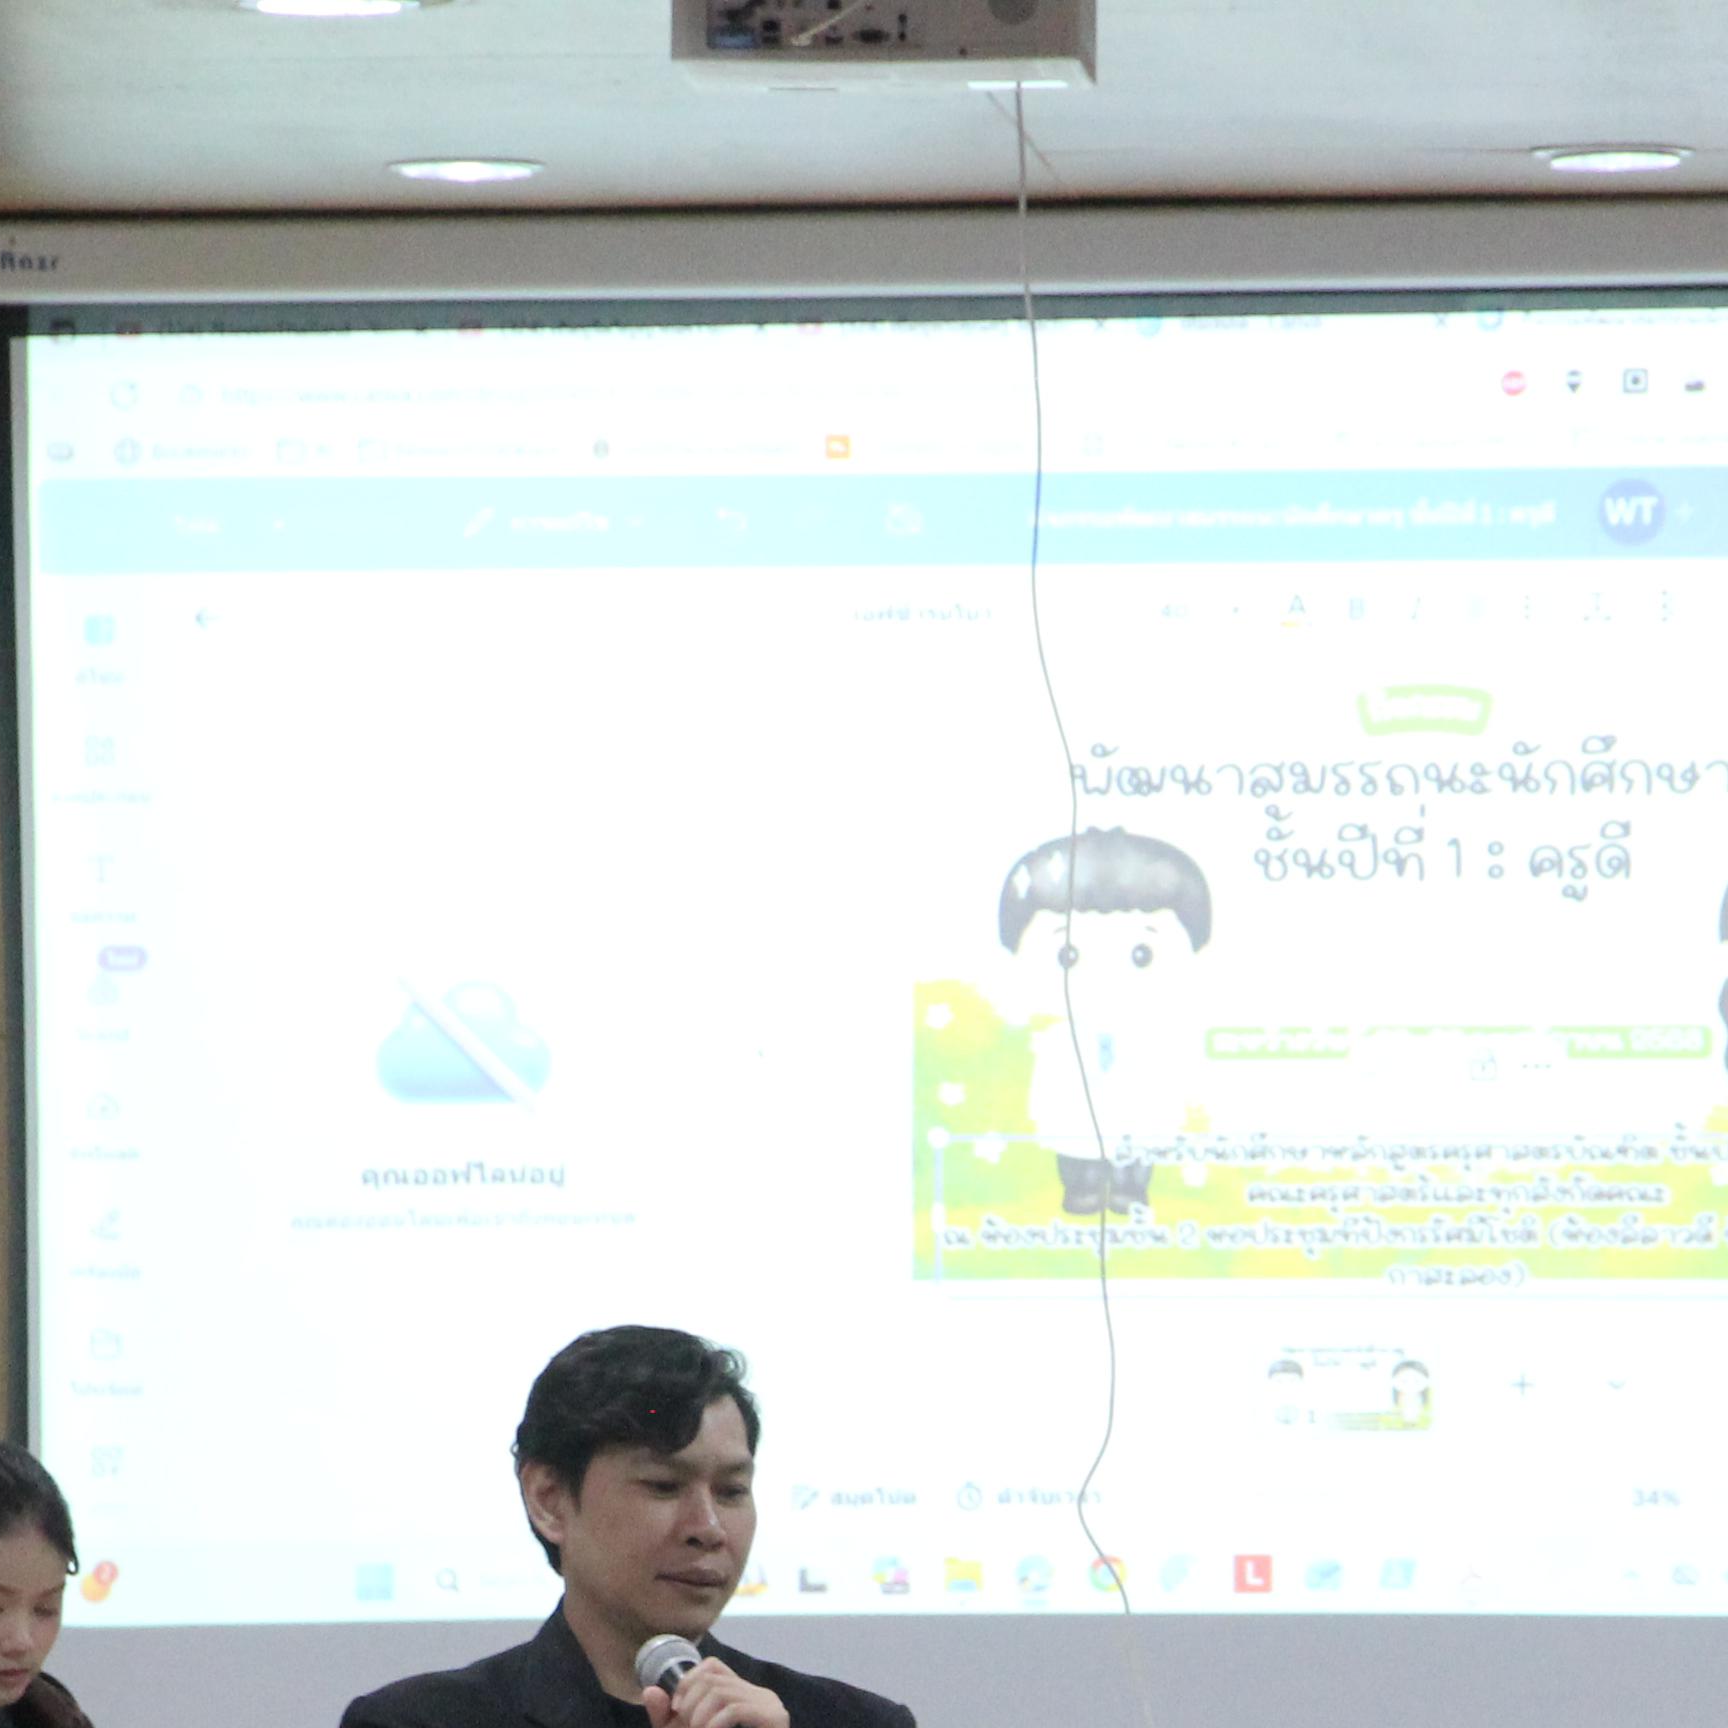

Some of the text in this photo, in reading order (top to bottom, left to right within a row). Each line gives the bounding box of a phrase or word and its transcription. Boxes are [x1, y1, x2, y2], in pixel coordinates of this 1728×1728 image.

[1605, 496, 1659, 526] WT
[1254, 804, 1425, 881] ชั้นปีที่
[1447, 837, 1463, 879] 1
[1528, 821, 1632, 902] ครูดี
